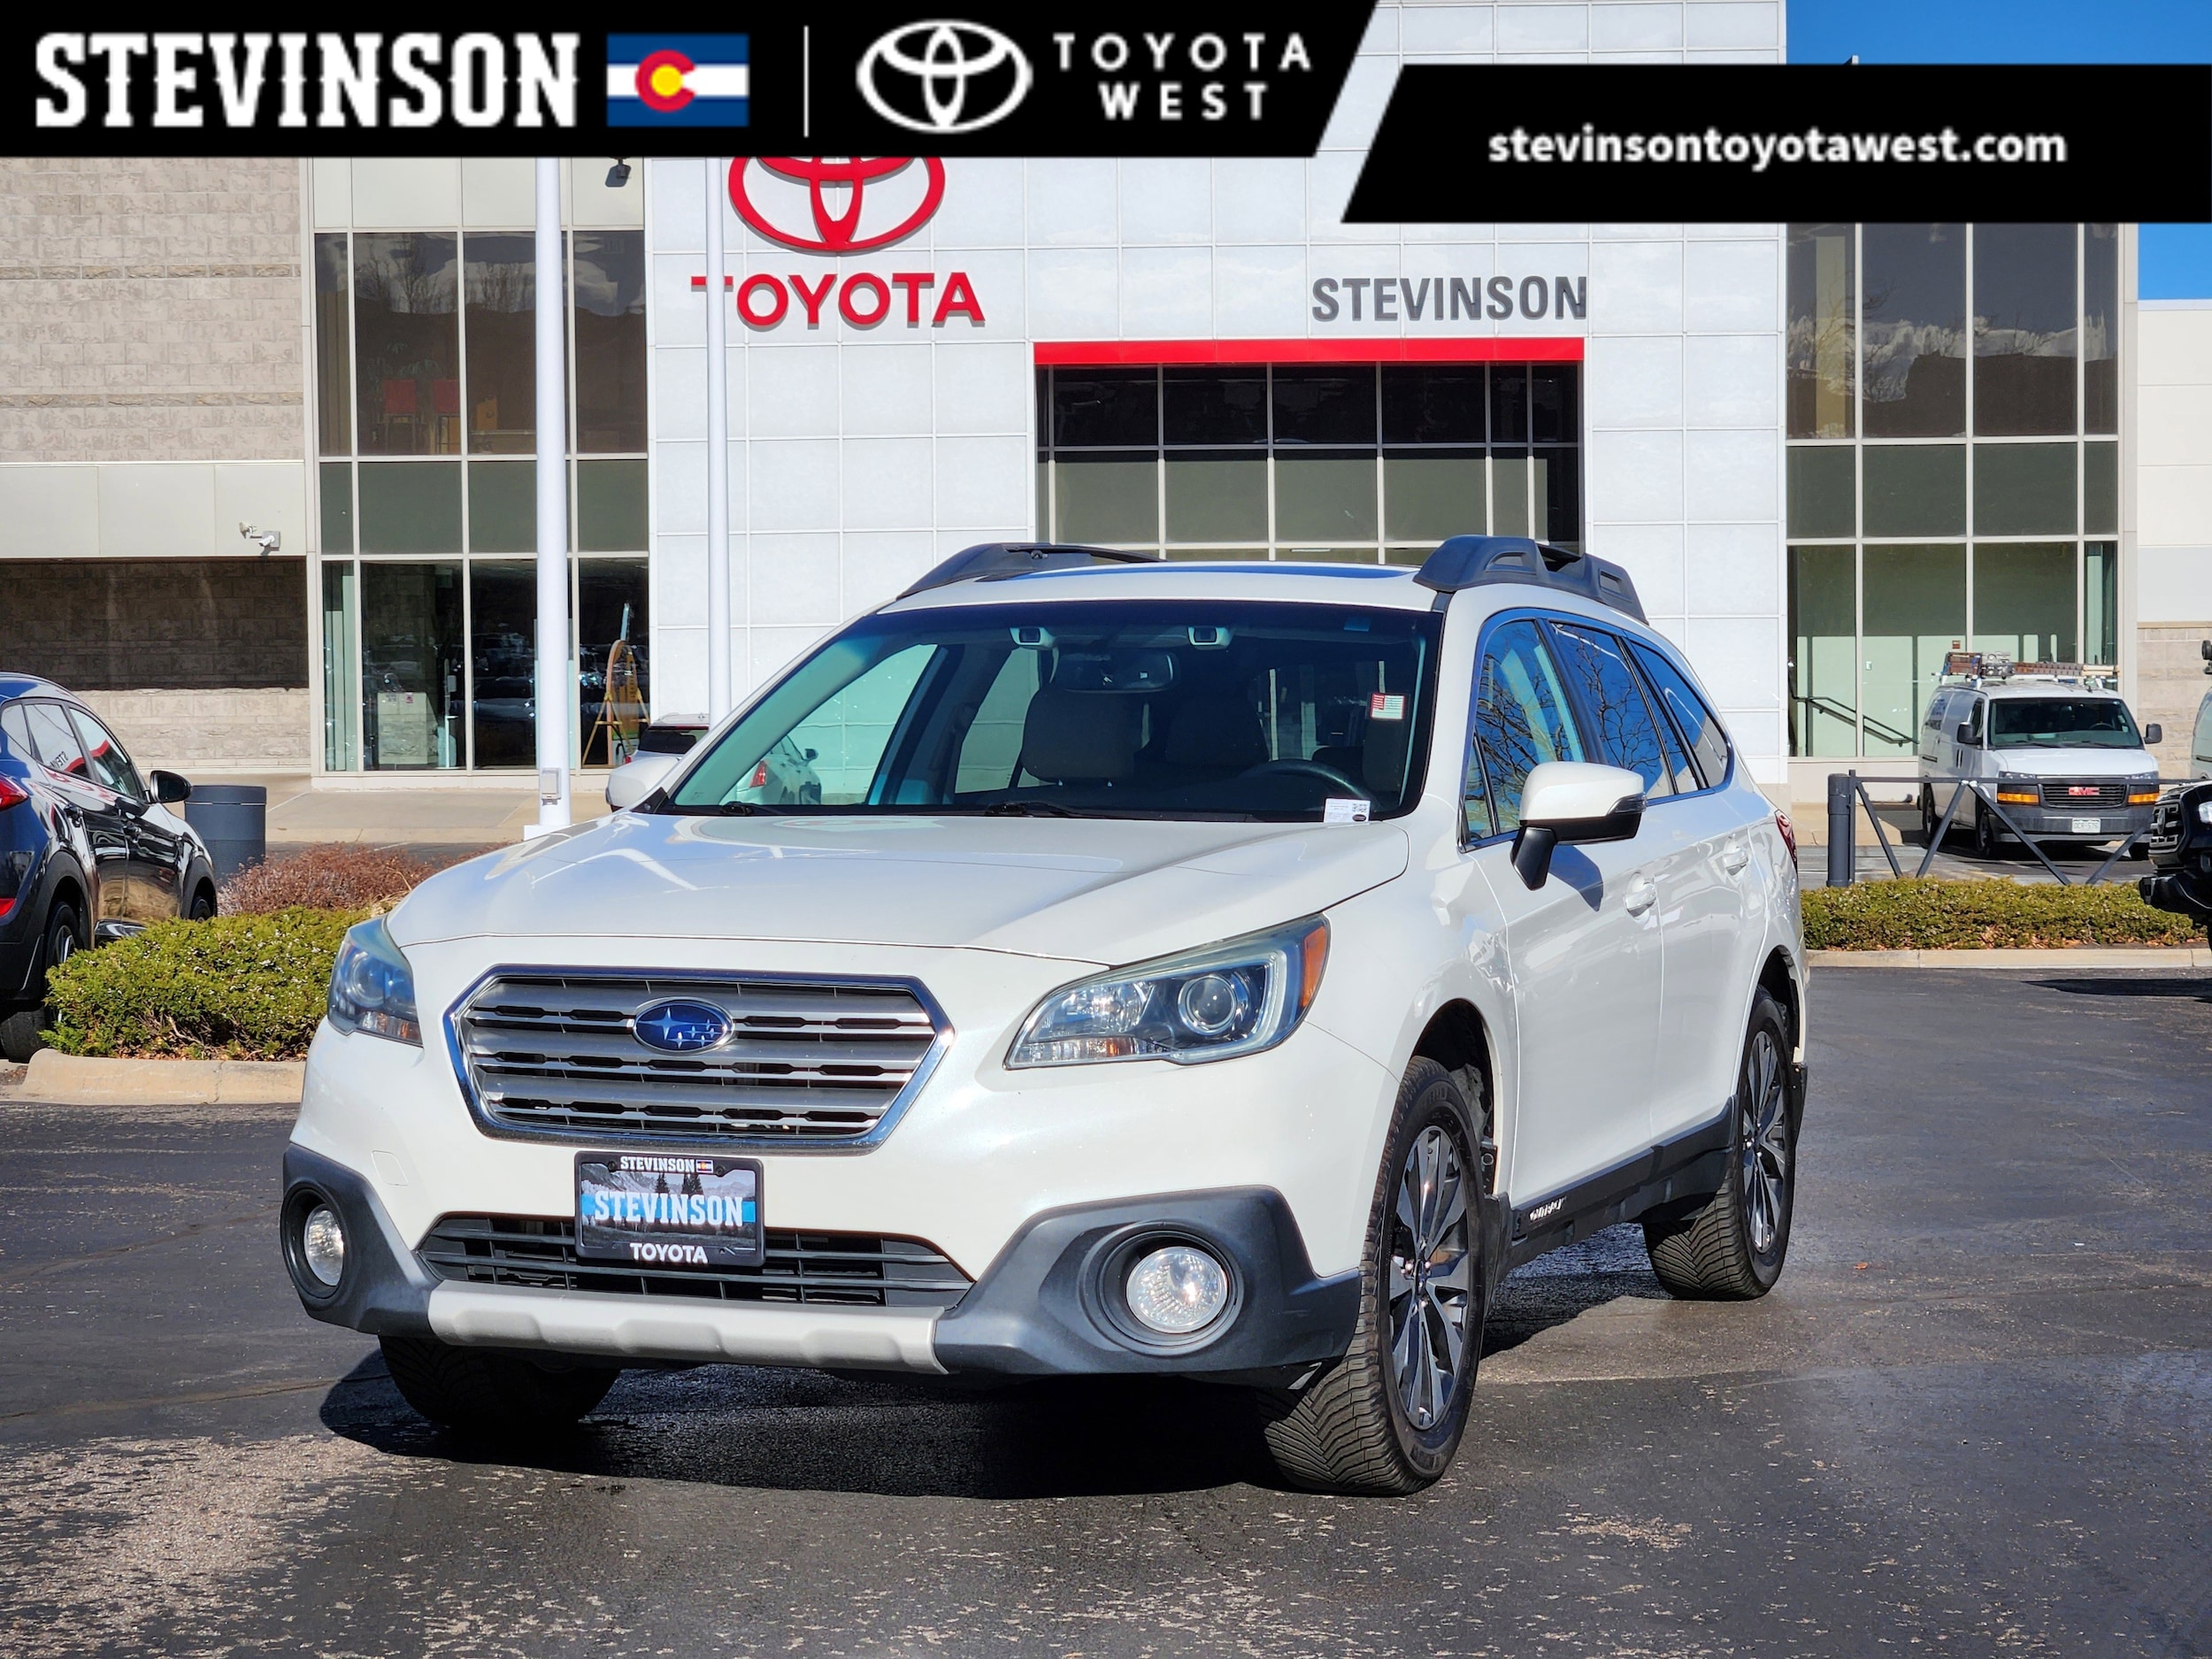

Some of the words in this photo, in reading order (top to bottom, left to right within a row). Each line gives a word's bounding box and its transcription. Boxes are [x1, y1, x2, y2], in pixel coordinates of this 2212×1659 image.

[1313, 275, 1587, 321] STEVINSON
[2068, 787, 2101, 796] GMC
[620, 1156, 695, 1173] STEVINSON
[595, 1190, 744, 1228] STEVINSON
[629, 1242, 709, 1264] TOYOTA
